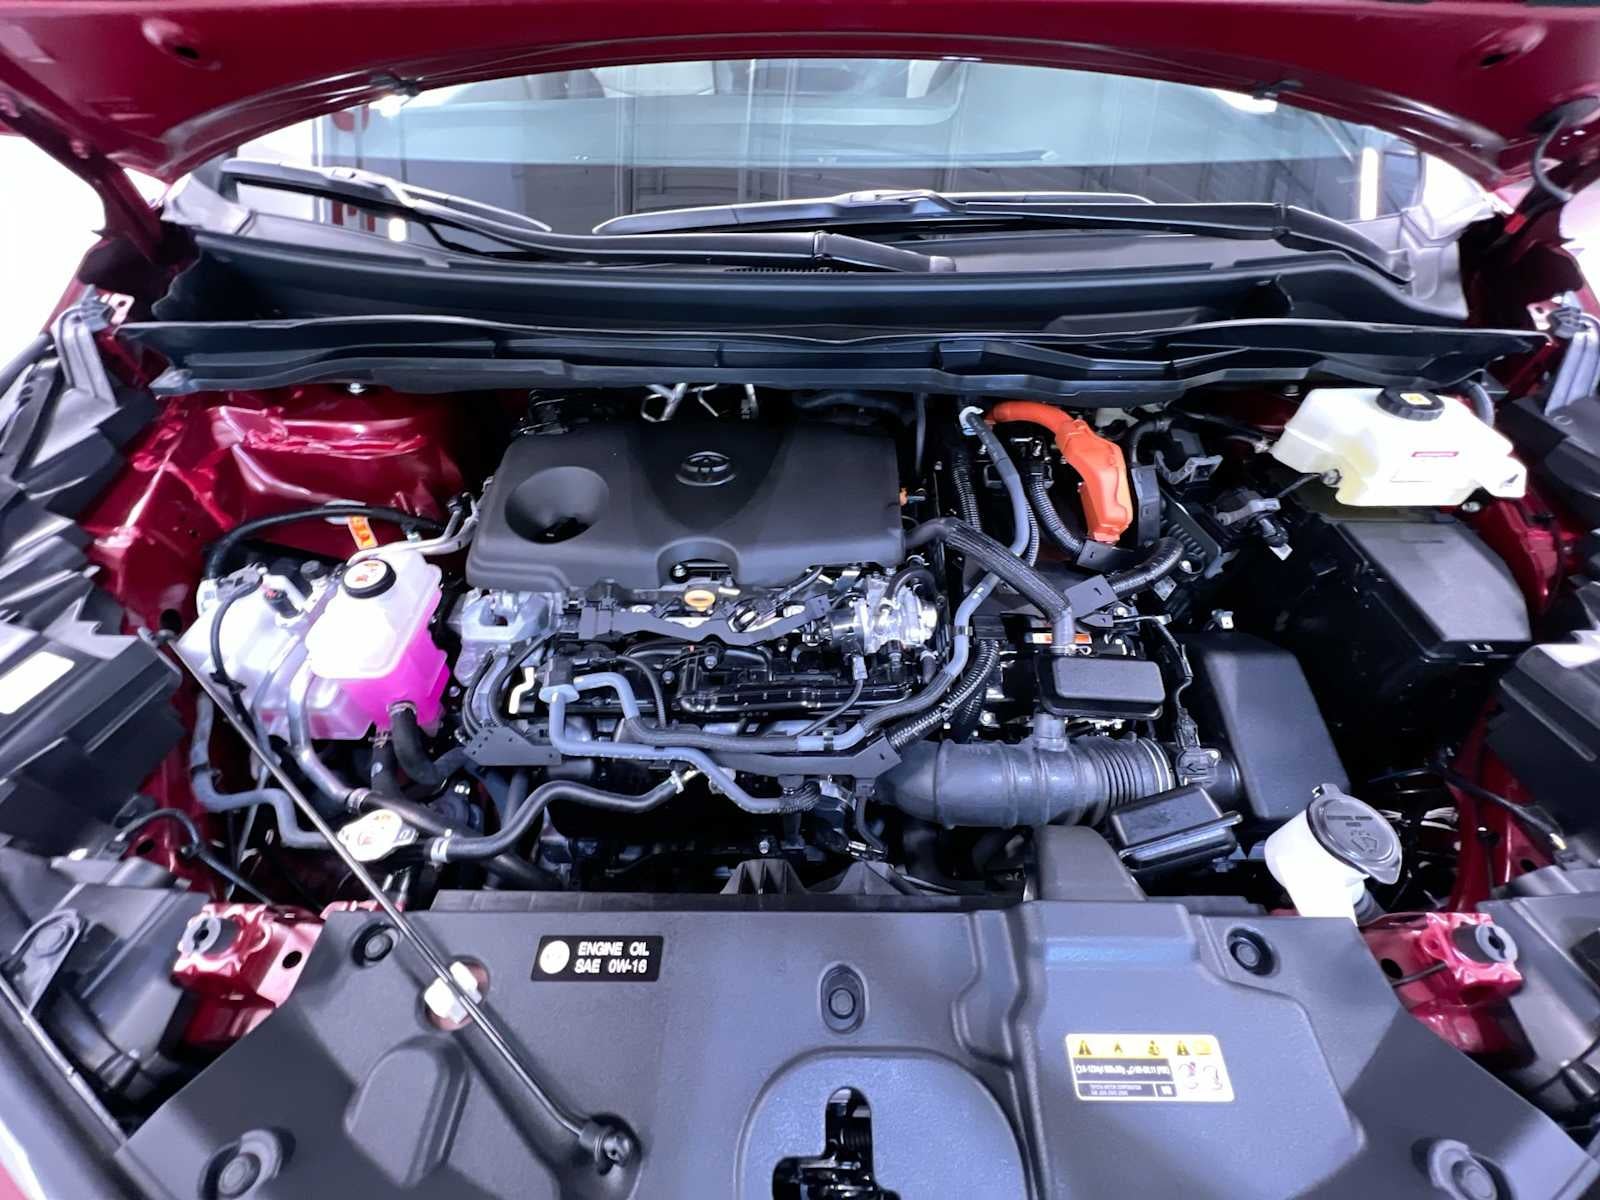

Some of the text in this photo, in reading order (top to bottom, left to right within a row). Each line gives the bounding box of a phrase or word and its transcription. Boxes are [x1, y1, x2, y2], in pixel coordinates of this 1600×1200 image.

[577, 941, 650, 956] ENGINE OIL
[574, 958, 648, 973] SAE 0W-16
